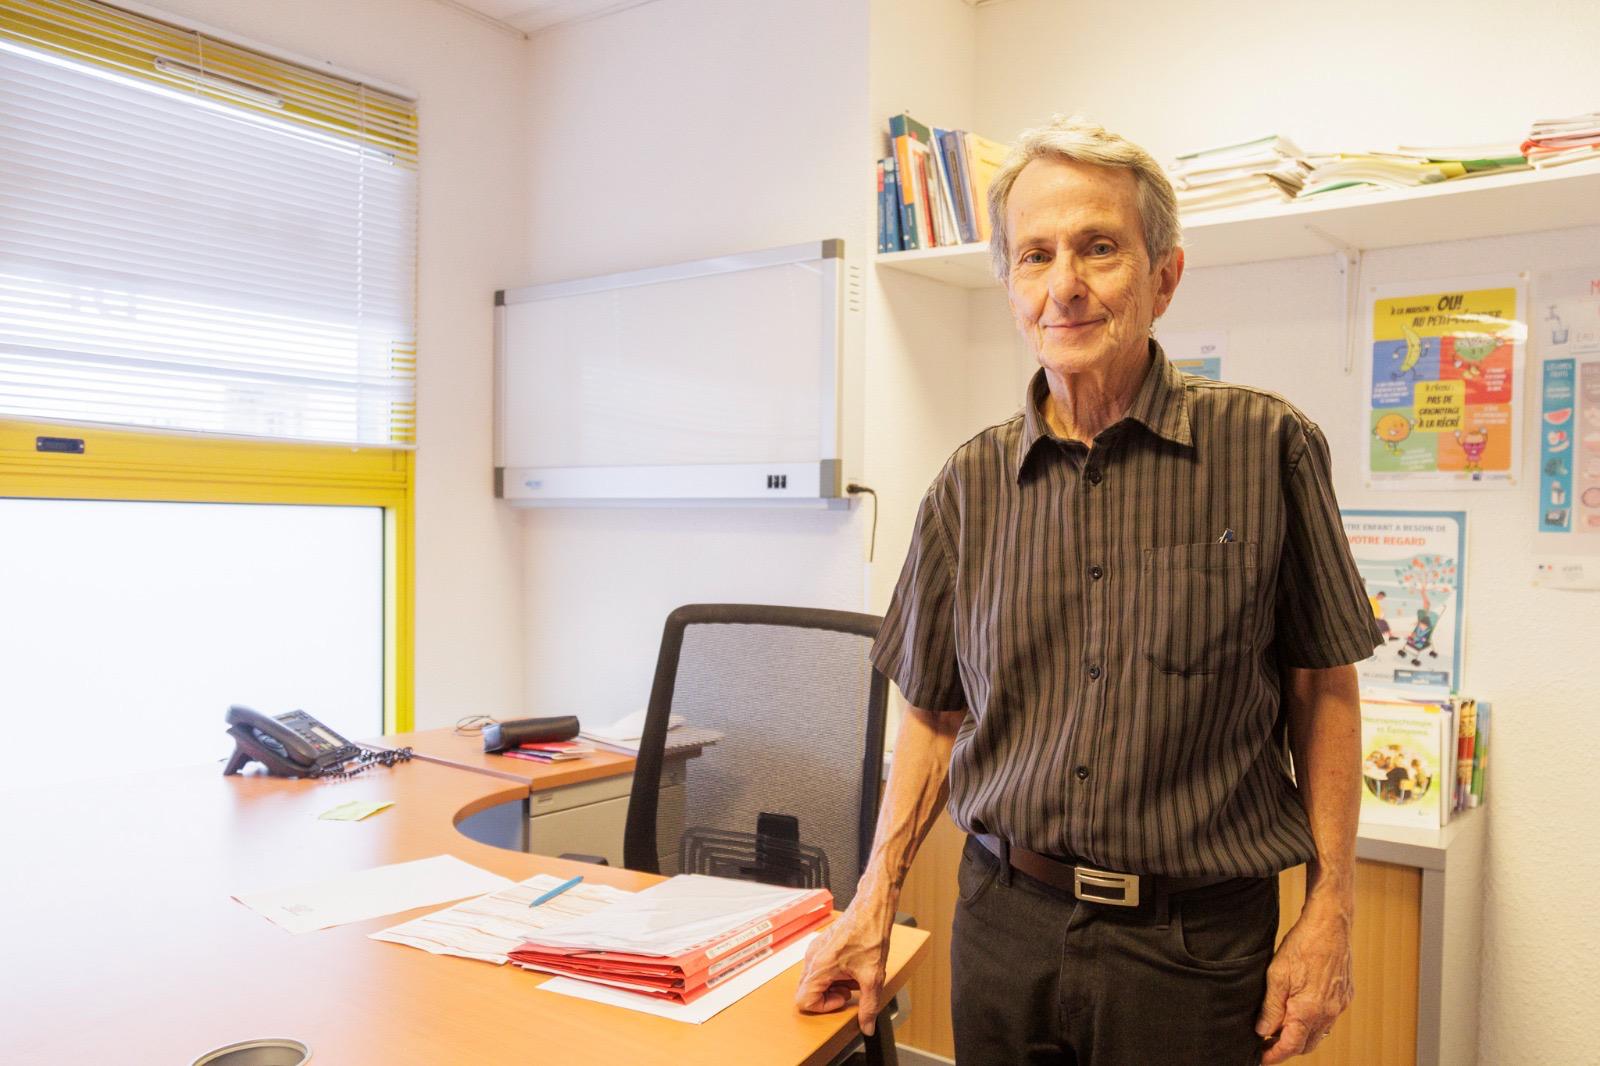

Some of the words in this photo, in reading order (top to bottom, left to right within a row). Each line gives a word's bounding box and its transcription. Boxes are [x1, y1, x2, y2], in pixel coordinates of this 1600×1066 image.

[1426, 395, 1442, 404] PAS
[1443, 394, 1452, 404] DE
[1419, 407, 1460, 415] GRIGNOTAGE
[1425, 419, 1435, 428] LA
[1436, 416, 1460, 428] RÉCRÉ
[1363, 523, 1393, 531] ENFANT
[1403, 524, 1433, 532] BESOIN
[1436, 525, 1446, 533] DE
[1348, 535, 1380, 545] VOTRE
[1384, 536, 1426, 545] REGARD
